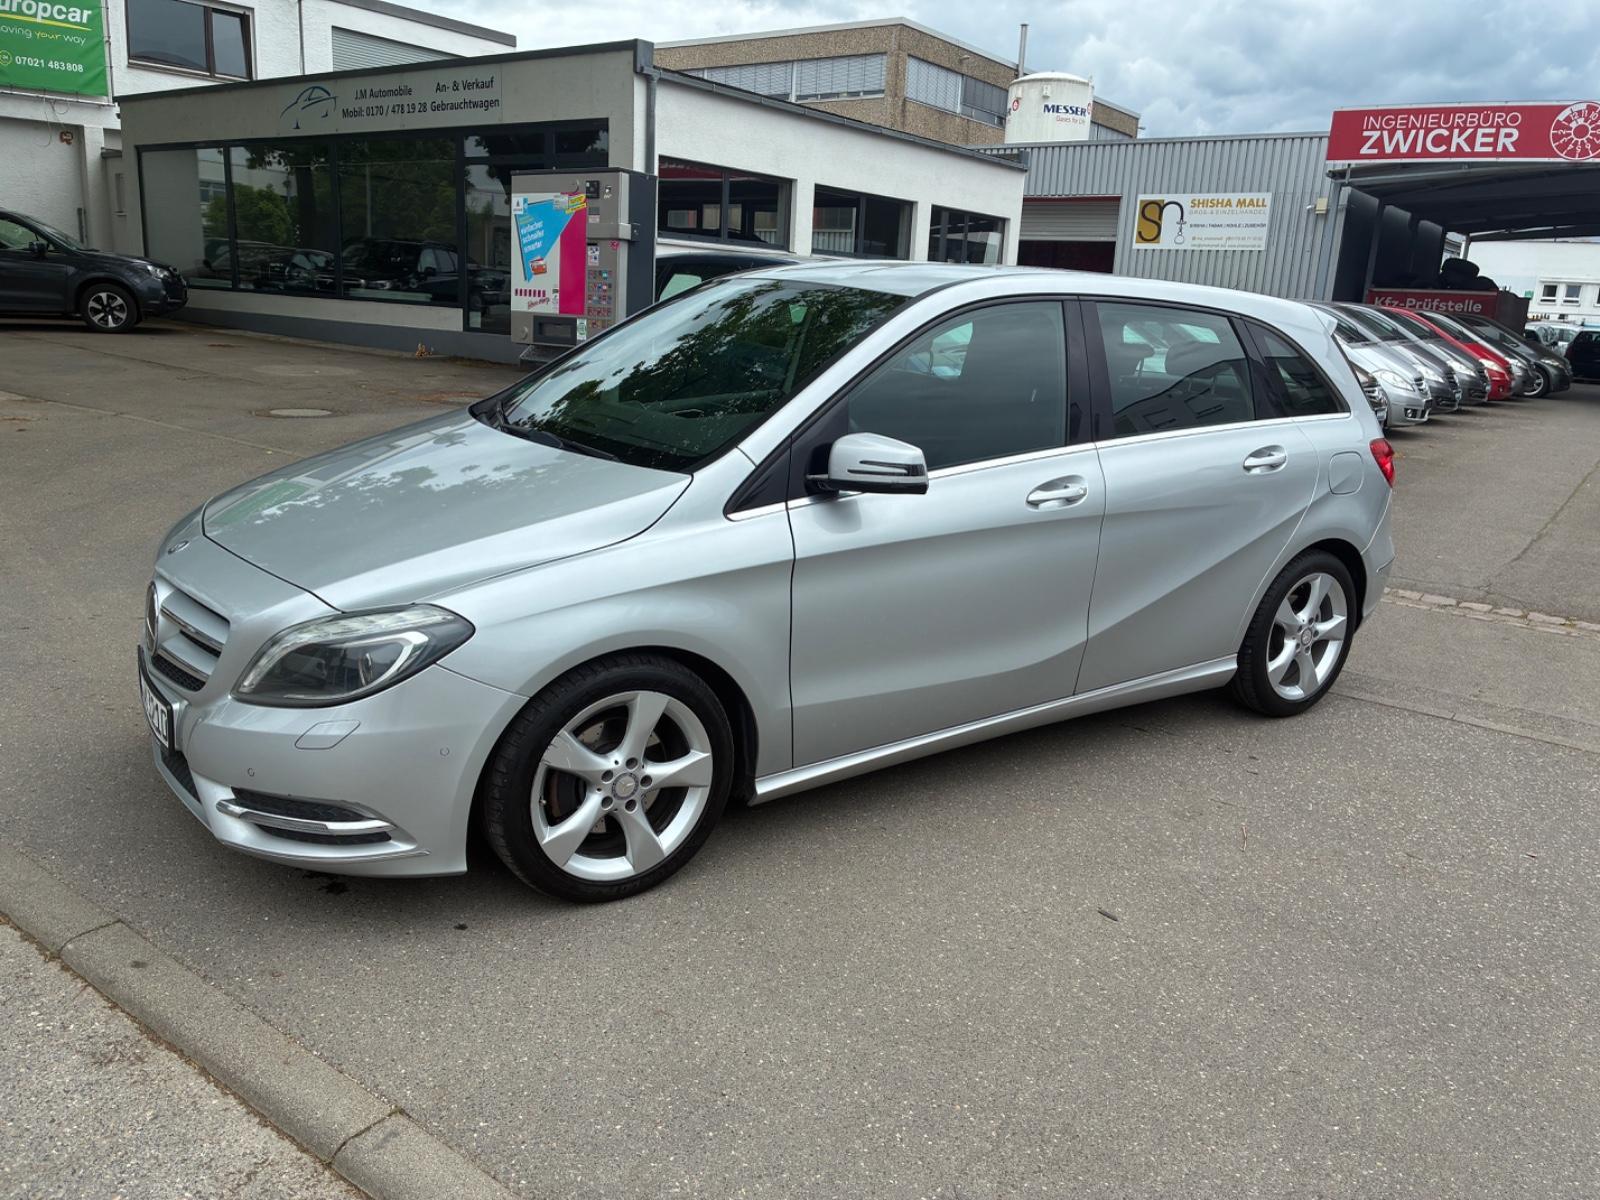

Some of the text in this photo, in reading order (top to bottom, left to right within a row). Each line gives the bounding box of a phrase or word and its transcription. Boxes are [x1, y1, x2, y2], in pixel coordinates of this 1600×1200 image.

[34, 31, 61, 40] your
[63, 35, 86, 47] way
[15, 56, 84, 72] 07021 483808
[369, 85, 413, 99] Automobile
[435, 75, 494, 93] An- & Verkauf
[342, 105, 365, 119] Mobil:
[366, 104, 384, 117] 0170
[391, 103, 405, 115] 478
[406, 103, 416, 114] 19
[417, 102, 428, 113] 28
[430, 98, 500, 112] Gebrauchtwagen
[1043, 103, 1087, 117] MESSER
[1362, 111, 1522, 130] INGENIEURBÜRO
[1359, 127, 1520, 155] ZWICKER
[1190, 197, 1268, 208] SHISHA MALL
[1374, 296, 1483, 313] Kfz-Prüfstelle
